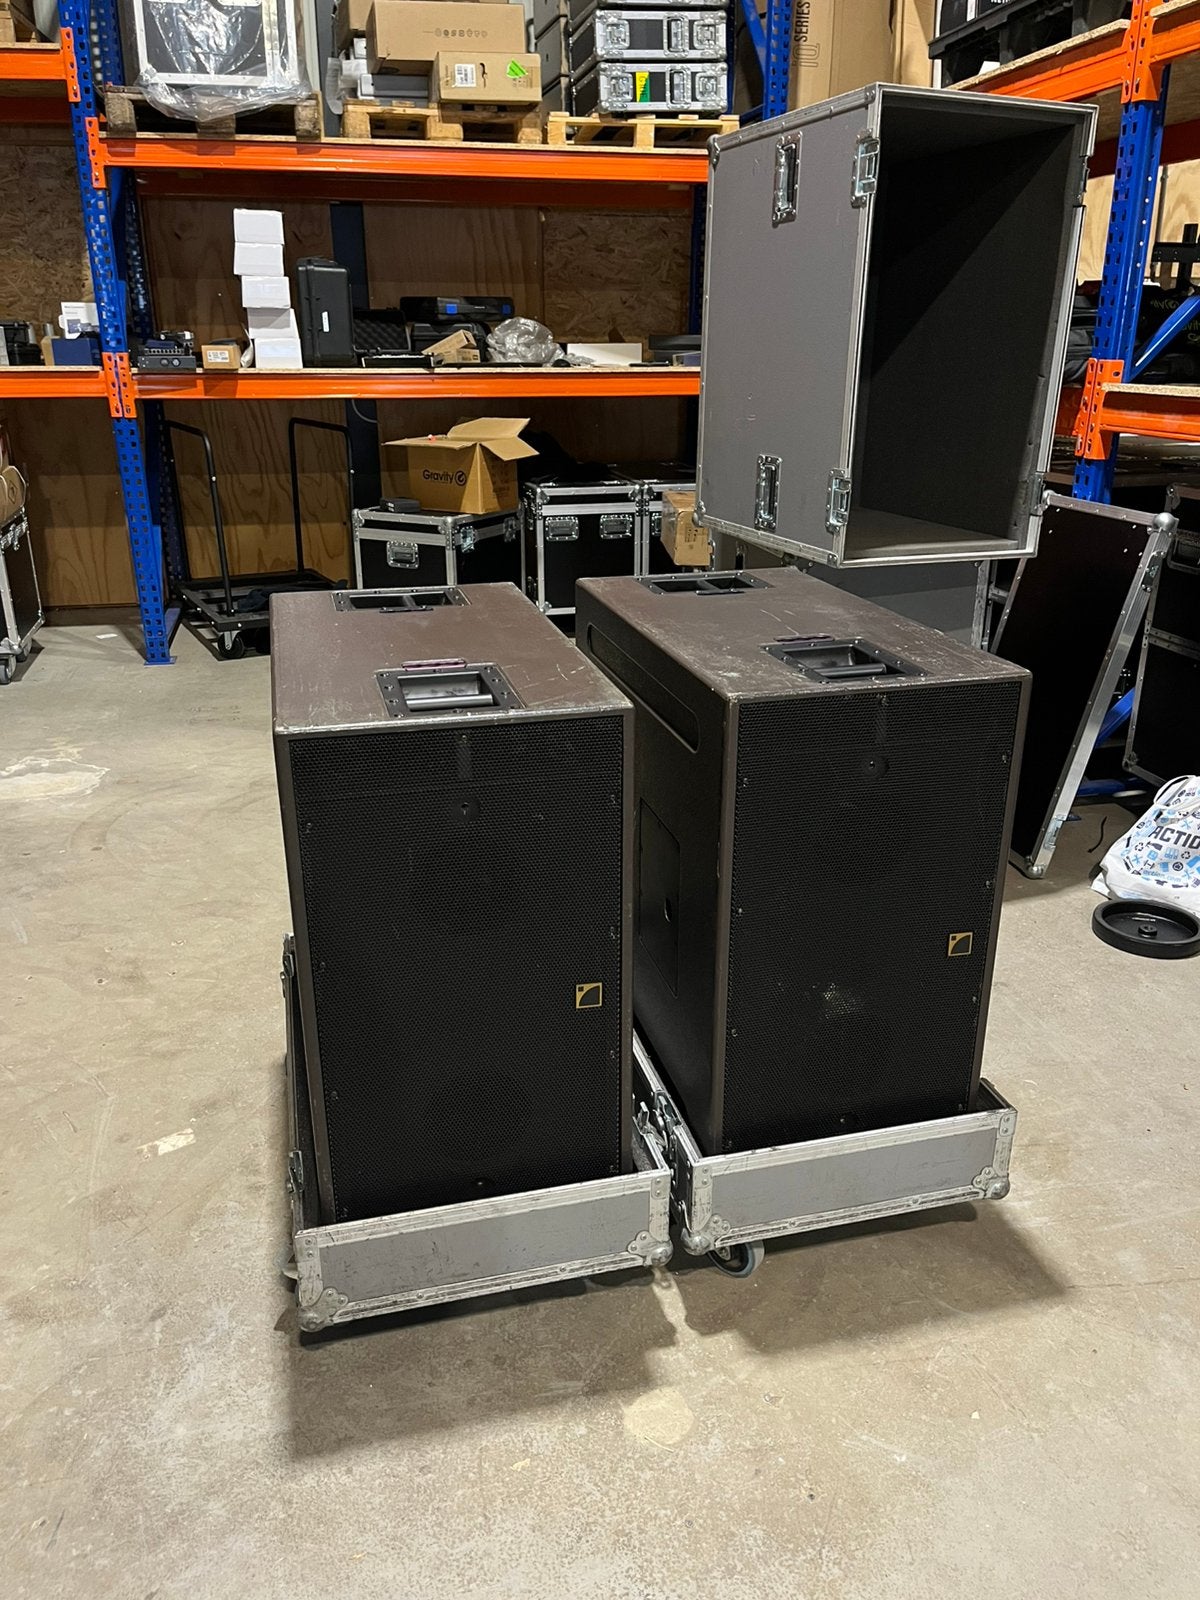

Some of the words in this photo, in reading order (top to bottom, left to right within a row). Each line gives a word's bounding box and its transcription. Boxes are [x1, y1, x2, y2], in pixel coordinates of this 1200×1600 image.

[794, 1, 810, 42] SERIES
[792, 43, 820, 67] IQ
[422, 469, 454, 484] Gravity
